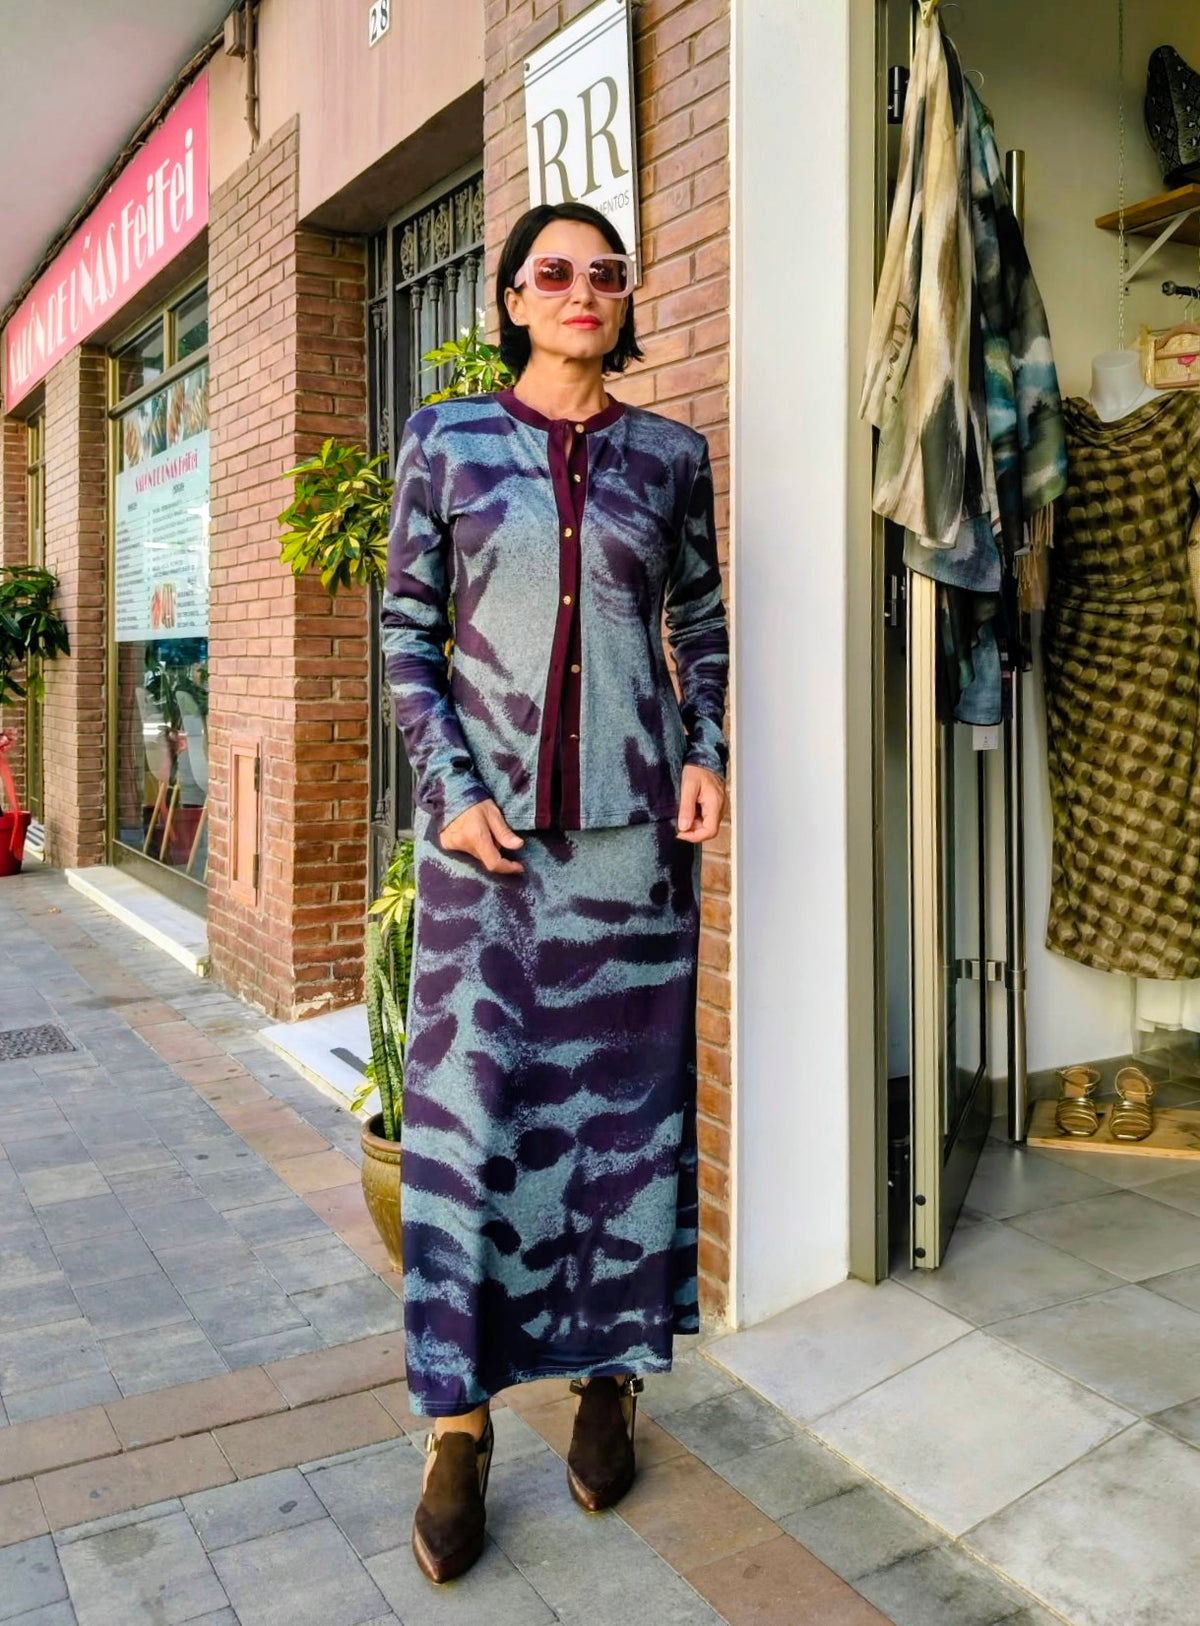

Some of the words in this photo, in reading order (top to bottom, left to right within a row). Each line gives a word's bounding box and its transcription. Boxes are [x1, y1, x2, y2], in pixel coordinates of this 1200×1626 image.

[371, 0, 388, 42] 28
[531, 76, 629, 205] RR
[48, 280, 67, 357] DE
[70, 222, 117, 333] UÑAS
[122, 128, 194, 284] FeiFei
